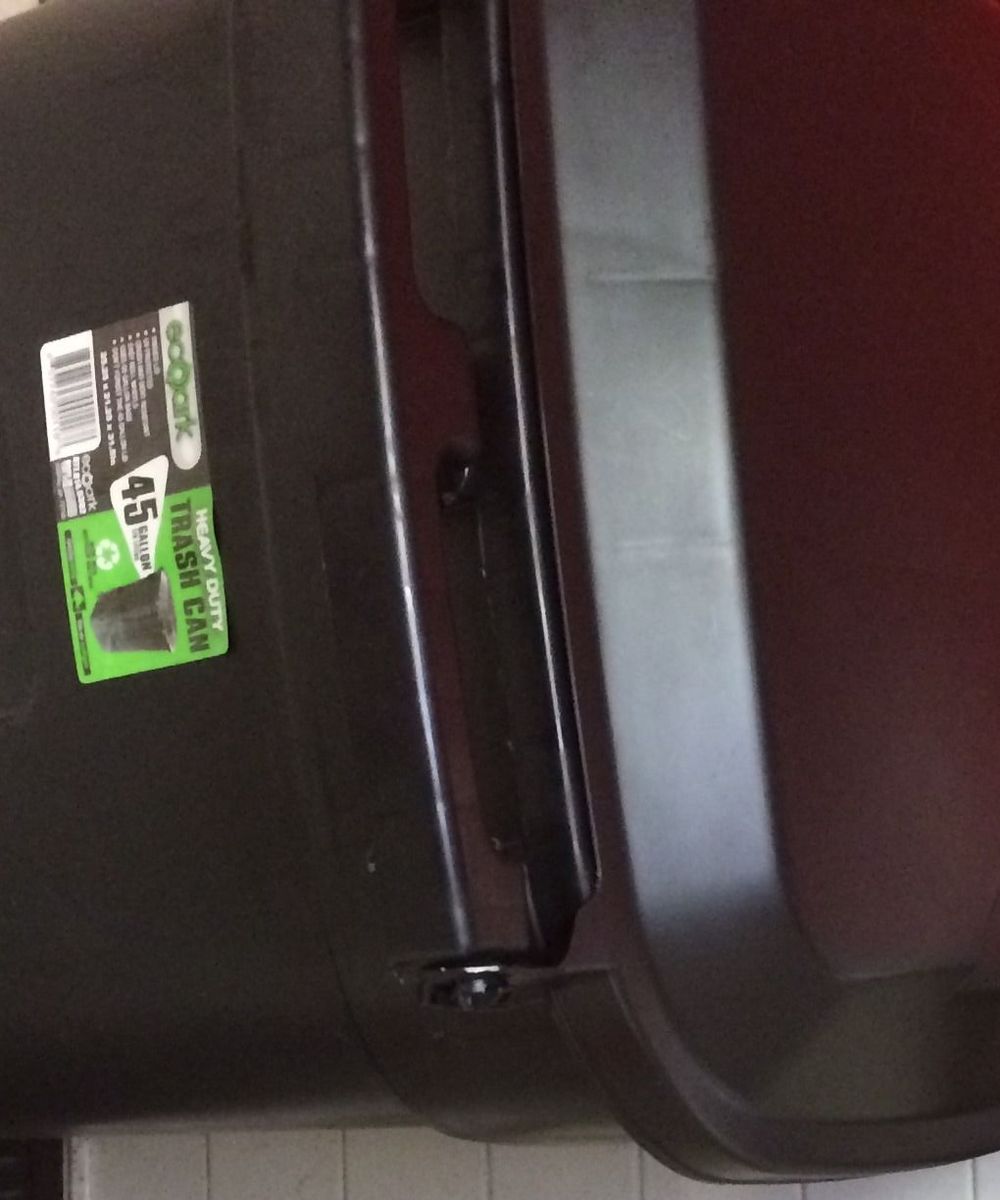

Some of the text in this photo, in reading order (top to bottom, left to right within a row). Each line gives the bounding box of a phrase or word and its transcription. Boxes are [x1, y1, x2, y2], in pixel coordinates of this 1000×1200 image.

[122, 475, 159, 572] 45 GALLON
[169, 499, 211, 654] TRASH CAN
[196, 508, 225, 633] HEAVY DUTY
